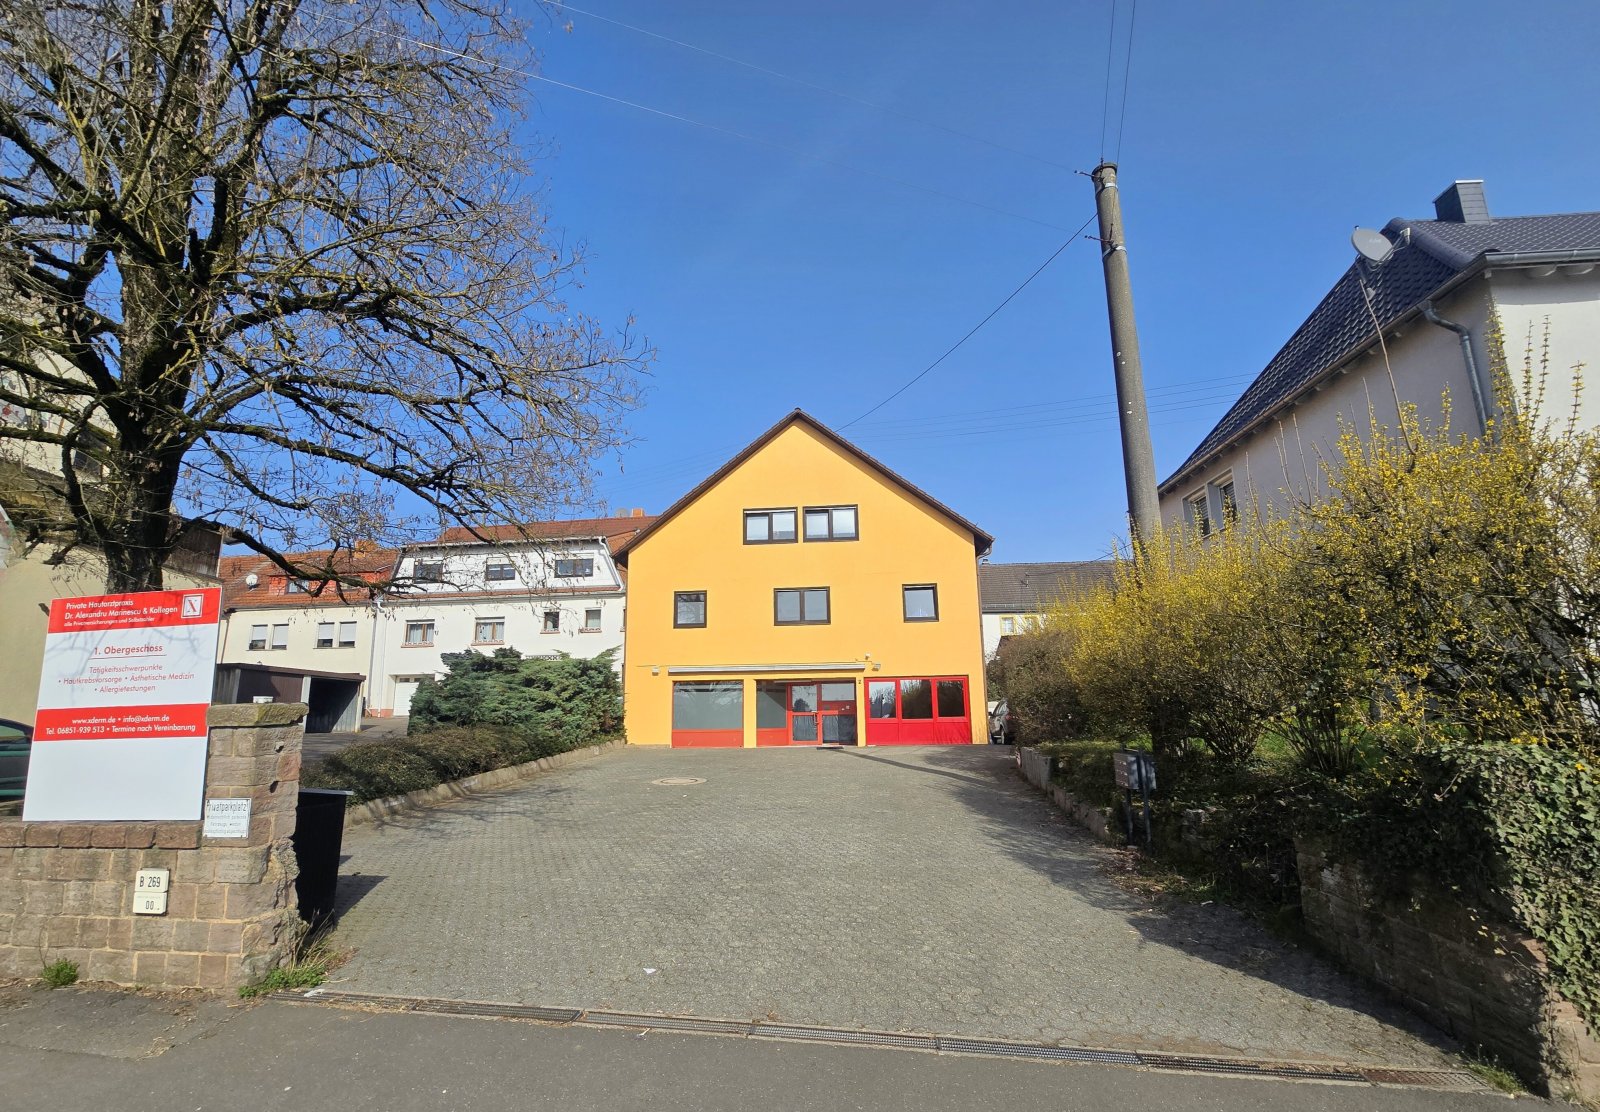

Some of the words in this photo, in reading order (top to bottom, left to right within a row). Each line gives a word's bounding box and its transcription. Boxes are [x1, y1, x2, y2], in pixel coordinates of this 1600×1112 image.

[66, 602, 87, 610] Private
[88, 600, 134, 609] Hautarztpraxis
[64, 612, 73, 620] Dr.
[75, 610, 107, 618] Alexandru
[108, 609, 141, 617] Marinescu
[149, 606, 178, 615] Kollegen
[94, 647, 101, 655] 1.
[104, 644, 163, 656] Obergeschoss
[89, 663, 163, 674] Tätigkeitsschwerpunkte
[63, 675, 123, 685] Hautkrebsvorsorge
[129, 672, 167, 682] Ästhetische
[168, 672, 194, 681] Medizin
[99, 685, 156, 694] Allergietestungen
[72, 715, 116, 724] www.xderm.de
[122, 714, 170, 723] info@xderm.de
[46, 727, 55, 735] Tel.
[57, 726, 91, 735] 06851-939
[92, 725, 104, 733] 513
[112, 725, 136, 733] Termine
[137, 724, 152, 732] nach
[154, 724, 196, 733] Vereinbarung
[139, 876, 145, 888] B
[147, 876, 161, 888] 269
